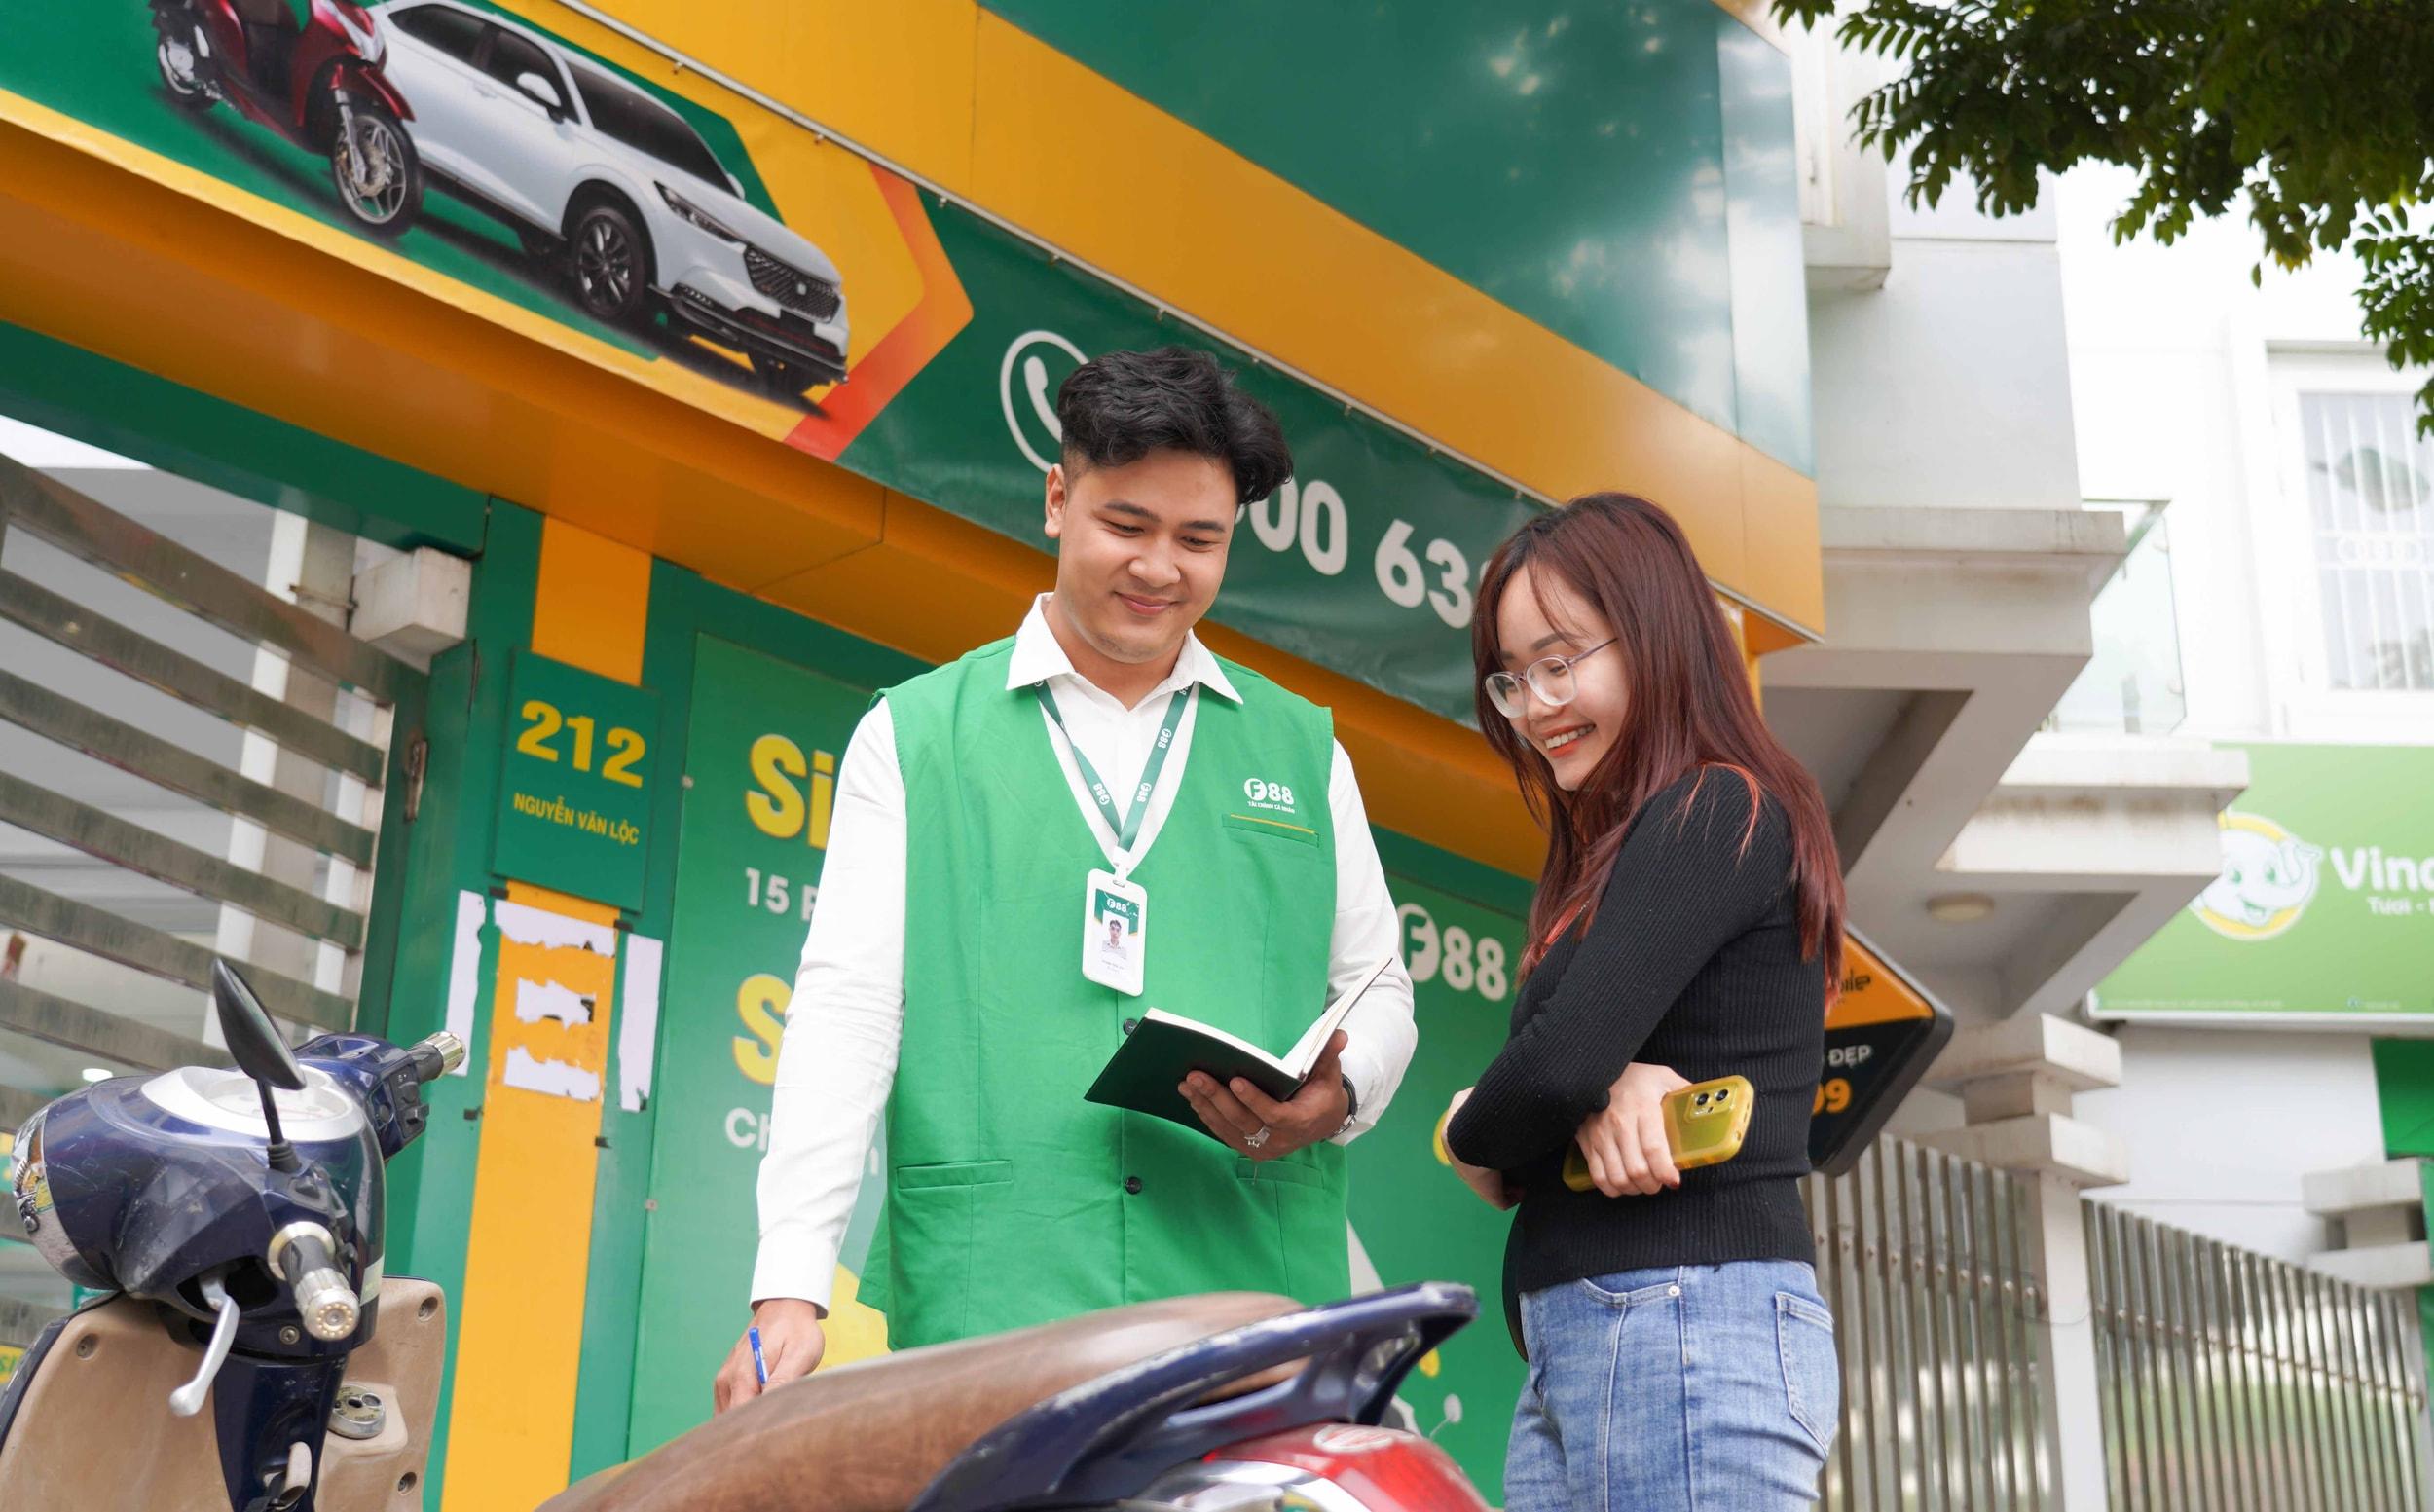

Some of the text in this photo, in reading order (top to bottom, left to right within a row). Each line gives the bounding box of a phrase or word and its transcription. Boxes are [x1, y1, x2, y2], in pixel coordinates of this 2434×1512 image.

[1235, 475, 1491, 629] 00 63
[517, 700, 645, 788] 212
[1244, 778, 1294, 805] F88
[514, 793, 640, 845] NGUYỄN VĂN LỘC
[746, 867, 790, 914] 15
[1396, 903, 1507, 1001] F88
[1828, 1044, 1873, 1068] ĐẸP
